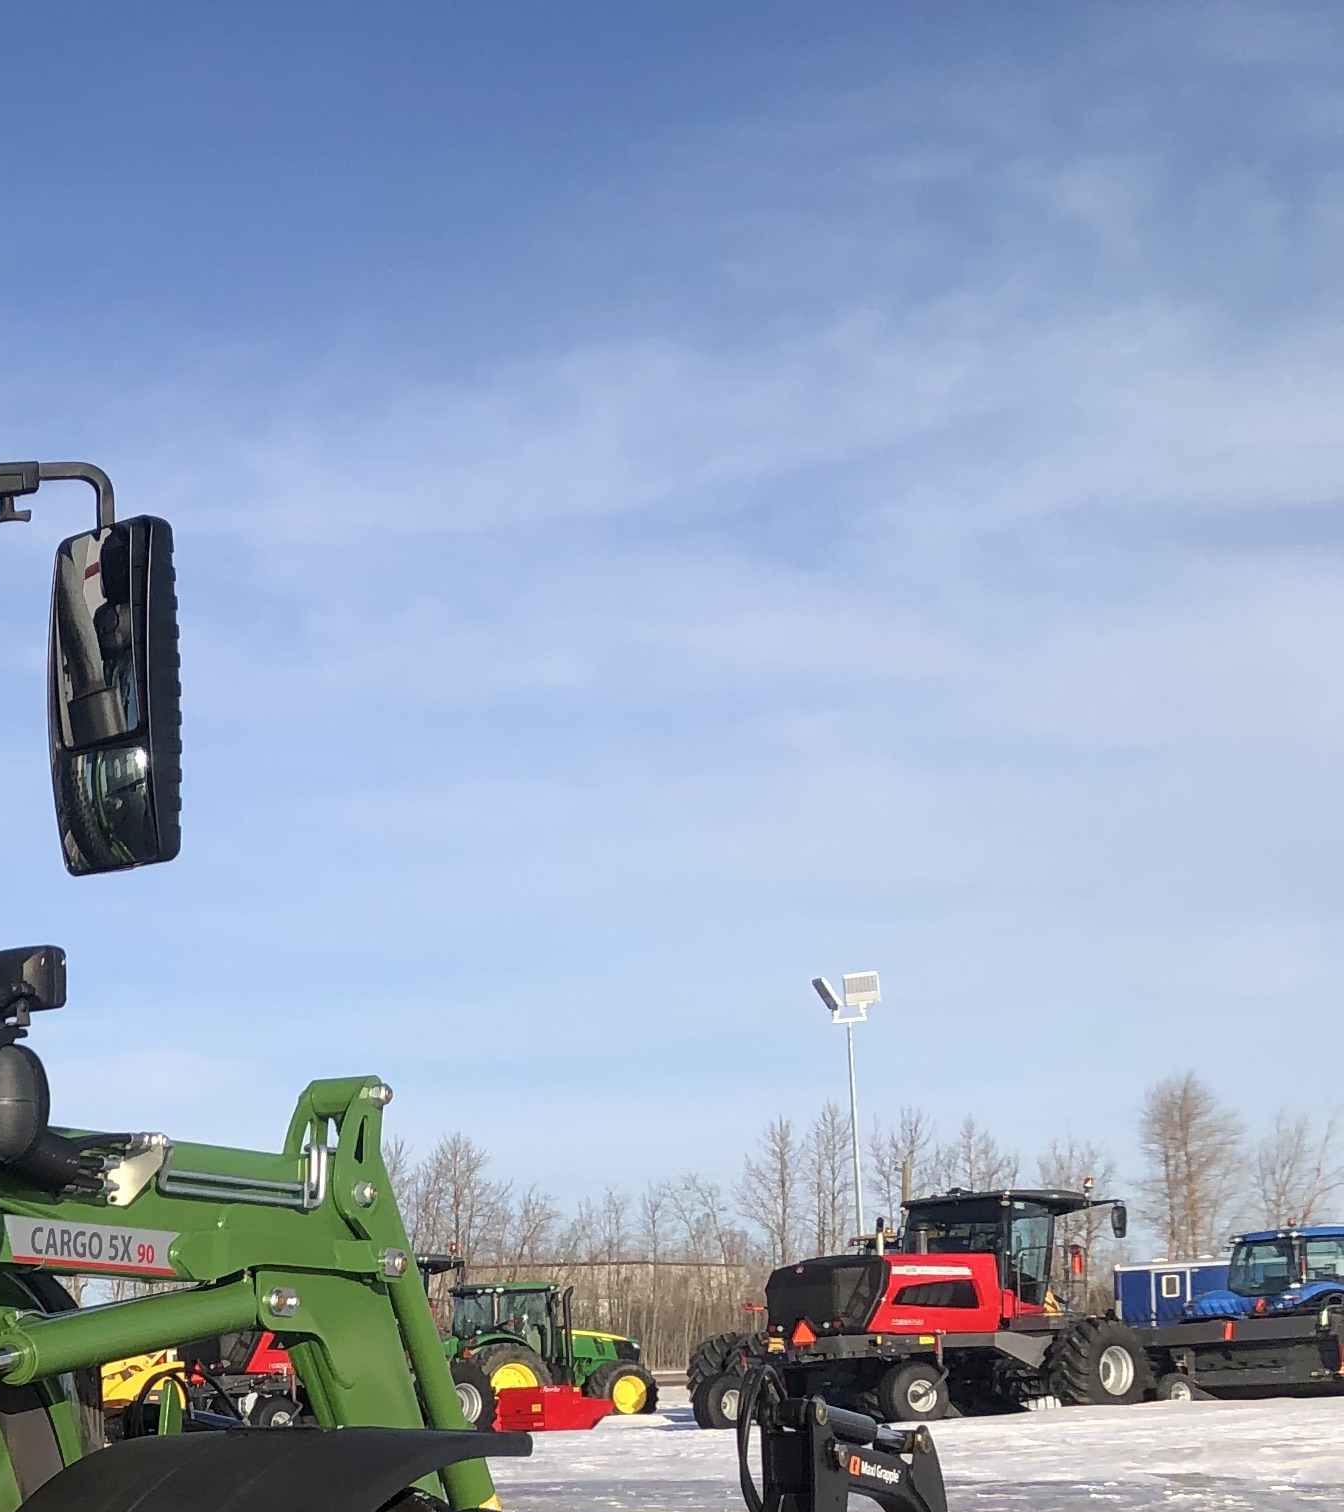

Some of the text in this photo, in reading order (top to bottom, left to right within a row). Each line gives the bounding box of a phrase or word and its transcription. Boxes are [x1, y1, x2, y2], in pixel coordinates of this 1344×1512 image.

[30, 1226, 155, 1265] CARGO 5X 90
[861, 1460, 876, 1477] Maxi
